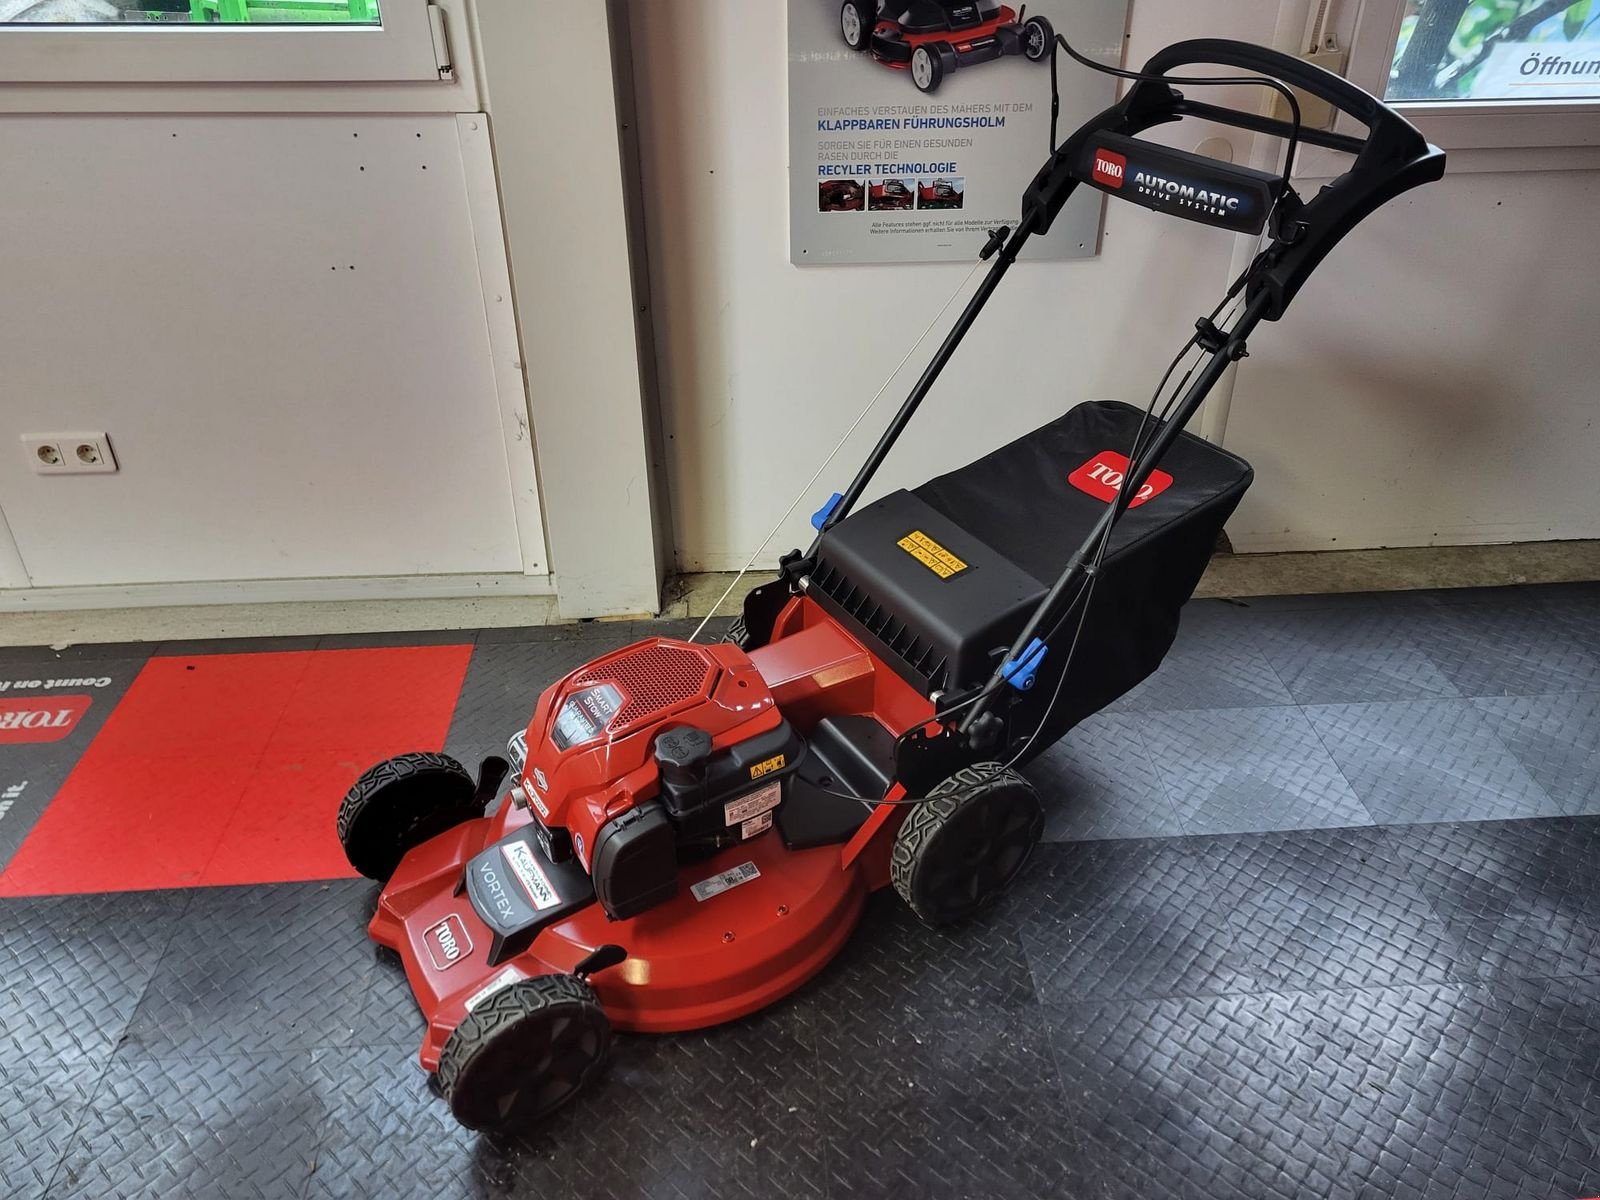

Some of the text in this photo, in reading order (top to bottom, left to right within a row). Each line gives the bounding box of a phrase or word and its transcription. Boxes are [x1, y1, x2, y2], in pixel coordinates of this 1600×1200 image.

[1519, 52, 1600, 77] Öffnun
[817, 101, 1033, 117] EINFACHES VERSTAUEN DES MÄHERS MIT DEM
[817, 115, 1006, 131] KLAPPBAREN FÜHRUNGSHOLM
[817, 138, 973, 150] SORGEN SIE FÜR EINEN GESUNDEN
[817, 151, 899, 161] RASEN DURCH DIE
[817, 162, 957, 176] RECYLER TECHNOLOGIE
[1096, 158, 1123, 178] TORO
[1134, 172, 1239, 211] AUTOMATIC
[1138, 186, 1226, 216] DRIVE SYSTEM
[0, 677, 112, 692] Count on i
[583, 696, 602, 719] STOW
[590, 688, 613, 715] SMART
[0, 709, 74, 729] TOR
[480, 862, 515, 920] VORTEX
[435, 921, 460, 960] TORO
